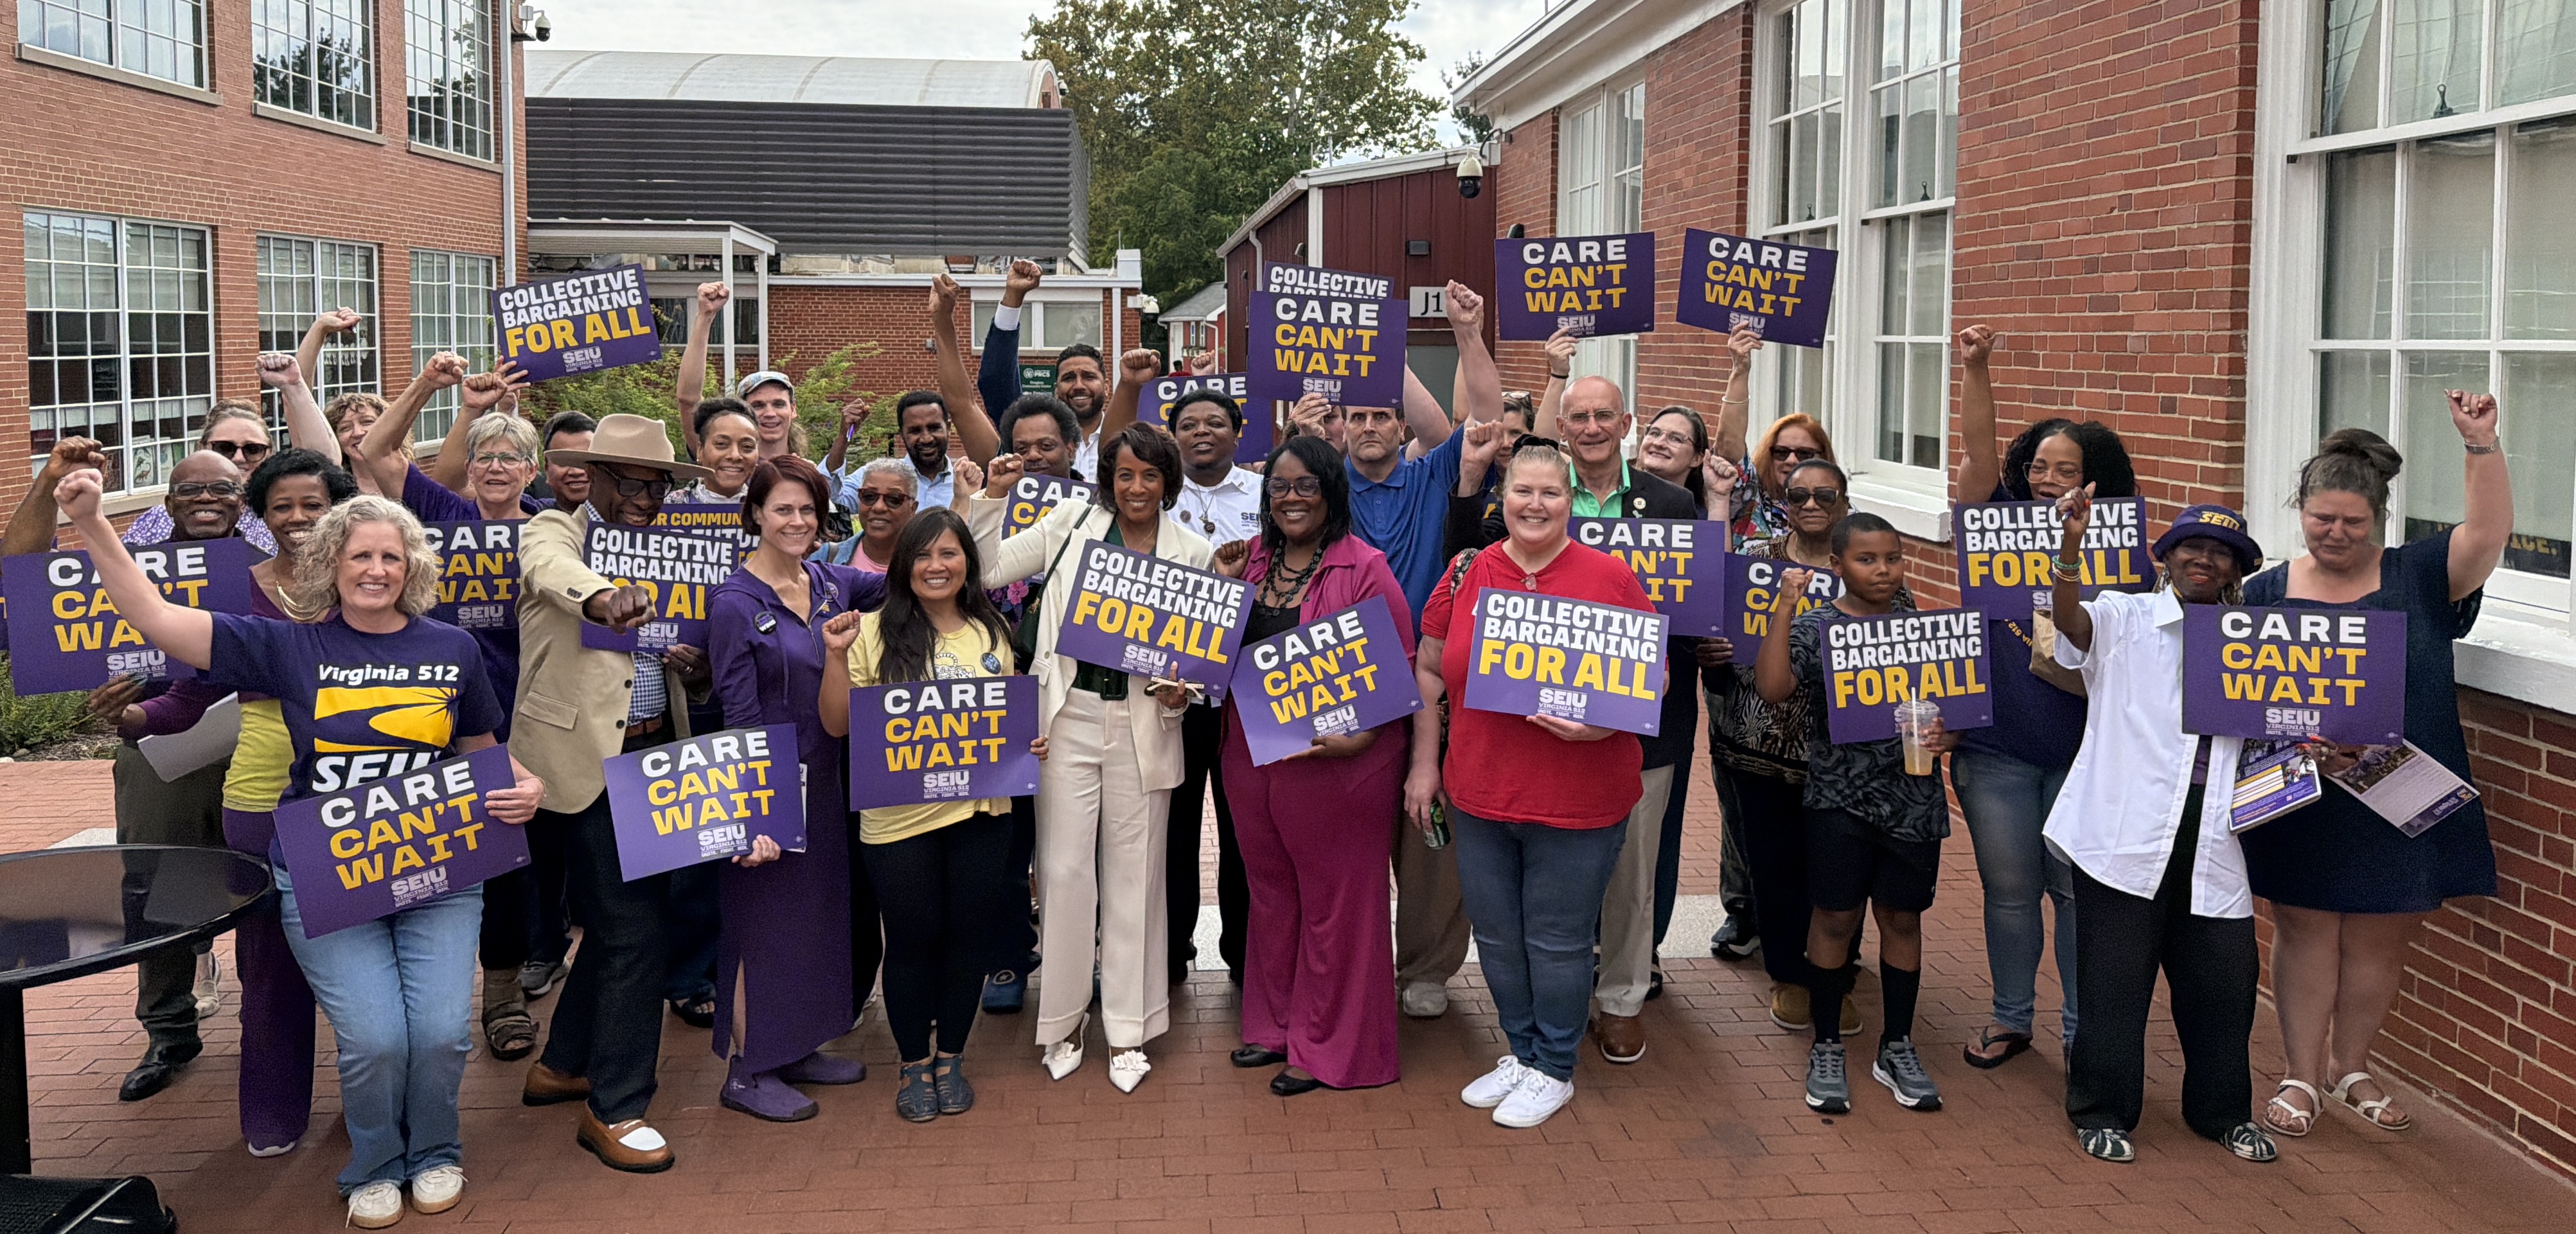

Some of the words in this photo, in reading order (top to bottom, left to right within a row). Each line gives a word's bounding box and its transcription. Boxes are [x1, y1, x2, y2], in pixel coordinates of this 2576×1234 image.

[1523, 239, 1627, 264] CARE
[1709, 237, 1809, 271] CARE
[499, 269, 639, 310] COLLECTIVE
[1270, 267, 1389, 297] COLLECTIVE
[1524, 263, 1627, 288] CAN'T
[1707, 260, 1806, 294] CAN'T
[502, 289, 642, 328] BARGAINING
[1276, 298, 1379, 326] CARE
[1421, 292, 1443, 315] J1
[1525, 288, 1627, 312] WAIT
[1705, 282, 1802, 317] WAIT
[506, 319, 578, 357] FOR
[586, 307, 651, 344] ALL
[1275, 324, 1378, 351] CAN'T
[1557, 315, 1595, 328] SEIU
[562, 347, 601, 364] SEIU
[1275, 348, 1376, 377] WAIT
[1302, 378, 1342, 392] SEIU
[1017, 477, 1091, 505] CAR
[671, 513, 743, 525] COMMUN
[1964, 502, 2137, 530] COLLECIVE
[592, 527, 733, 565] COLLECTIVE
[1579, 522, 1693, 548] CARE
[48, 547, 207, 586] CRE
[1089, 547, 1245, 608] COLLECTIVE
[1968, 552, 2052, 586] FOR
[52, 579, 208, 619] CA'T
[435, 578, 522, 603] WAI
[1082, 569, 1237, 628] BARGAINING
[457, 605, 504, 619] SEIU
[1073, 590, 1155, 643] FOR
[1157, 615, 1228, 664] ALL
[1487, 594, 1660, 641] COLLECTIVE
[2221, 612, 2366, 644] CARE
[55, 619, 145, 652] WA
[638, 623, 678, 638] SEIU
[1254, 610, 1364, 670] CARE
[1484, 617, 1657, 663] BARGAINING
[1829, 612, 1980, 648] COLLECTIVE
[107, 650, 166, 671] SEIU
[1123, 657, 1152, 669] VIRGINIA
[1124, 645, 1168, 667] SEIU
[1263, 637, 1368, 696] CAN'T
[1832, 636, 1982, 670] BARGAINING
[2222, 642, 2367, 674] CAN'T
[319, 664, 408, 685] Virginia
[418, 665, 459, 682] 512
[1479, 639, 1566, 684] FOR
[1573, 653, 1655, 701] ALL
[1834, 666, 1911, 708] FOR
[1919, 658, 1985, 700] ALL
[884, 682, 1006, 714] CARE
[1270, 664, 1378, 724] WAIT
[1539, 689, 1587, 707] SEIU
[2222, 673, 2366, 706] WAIT
[1313, 705, 1355, 731] SEIU
[1538, 703, 1572, 712] VIRGINIA
[2266, 709, 2320, 725] SEIU
[885, 710, 1007, 743] CAN'T
[1317, 723, 1347, 737] VIRGINIA
[642, 731, 769, 778] CARE
[885, 737, 1006, 771] WAIT
[321, 761, 474, 827] CARE
[648, 760, 771, 806] CAN'T
[923, 771, 970, 788] SEIU
[330, 793, 477, 858] CAN'T
[652, 789, 774, 835] WAIT
[698, 825, 746, 846] SEIU
[700, 840, 735, 852] VIRGINIA
[335, 823, 484, 890] WAIT
[391, 867, 447, 896] SEIU
[394, 885, 433, 902] VIRGINIA
